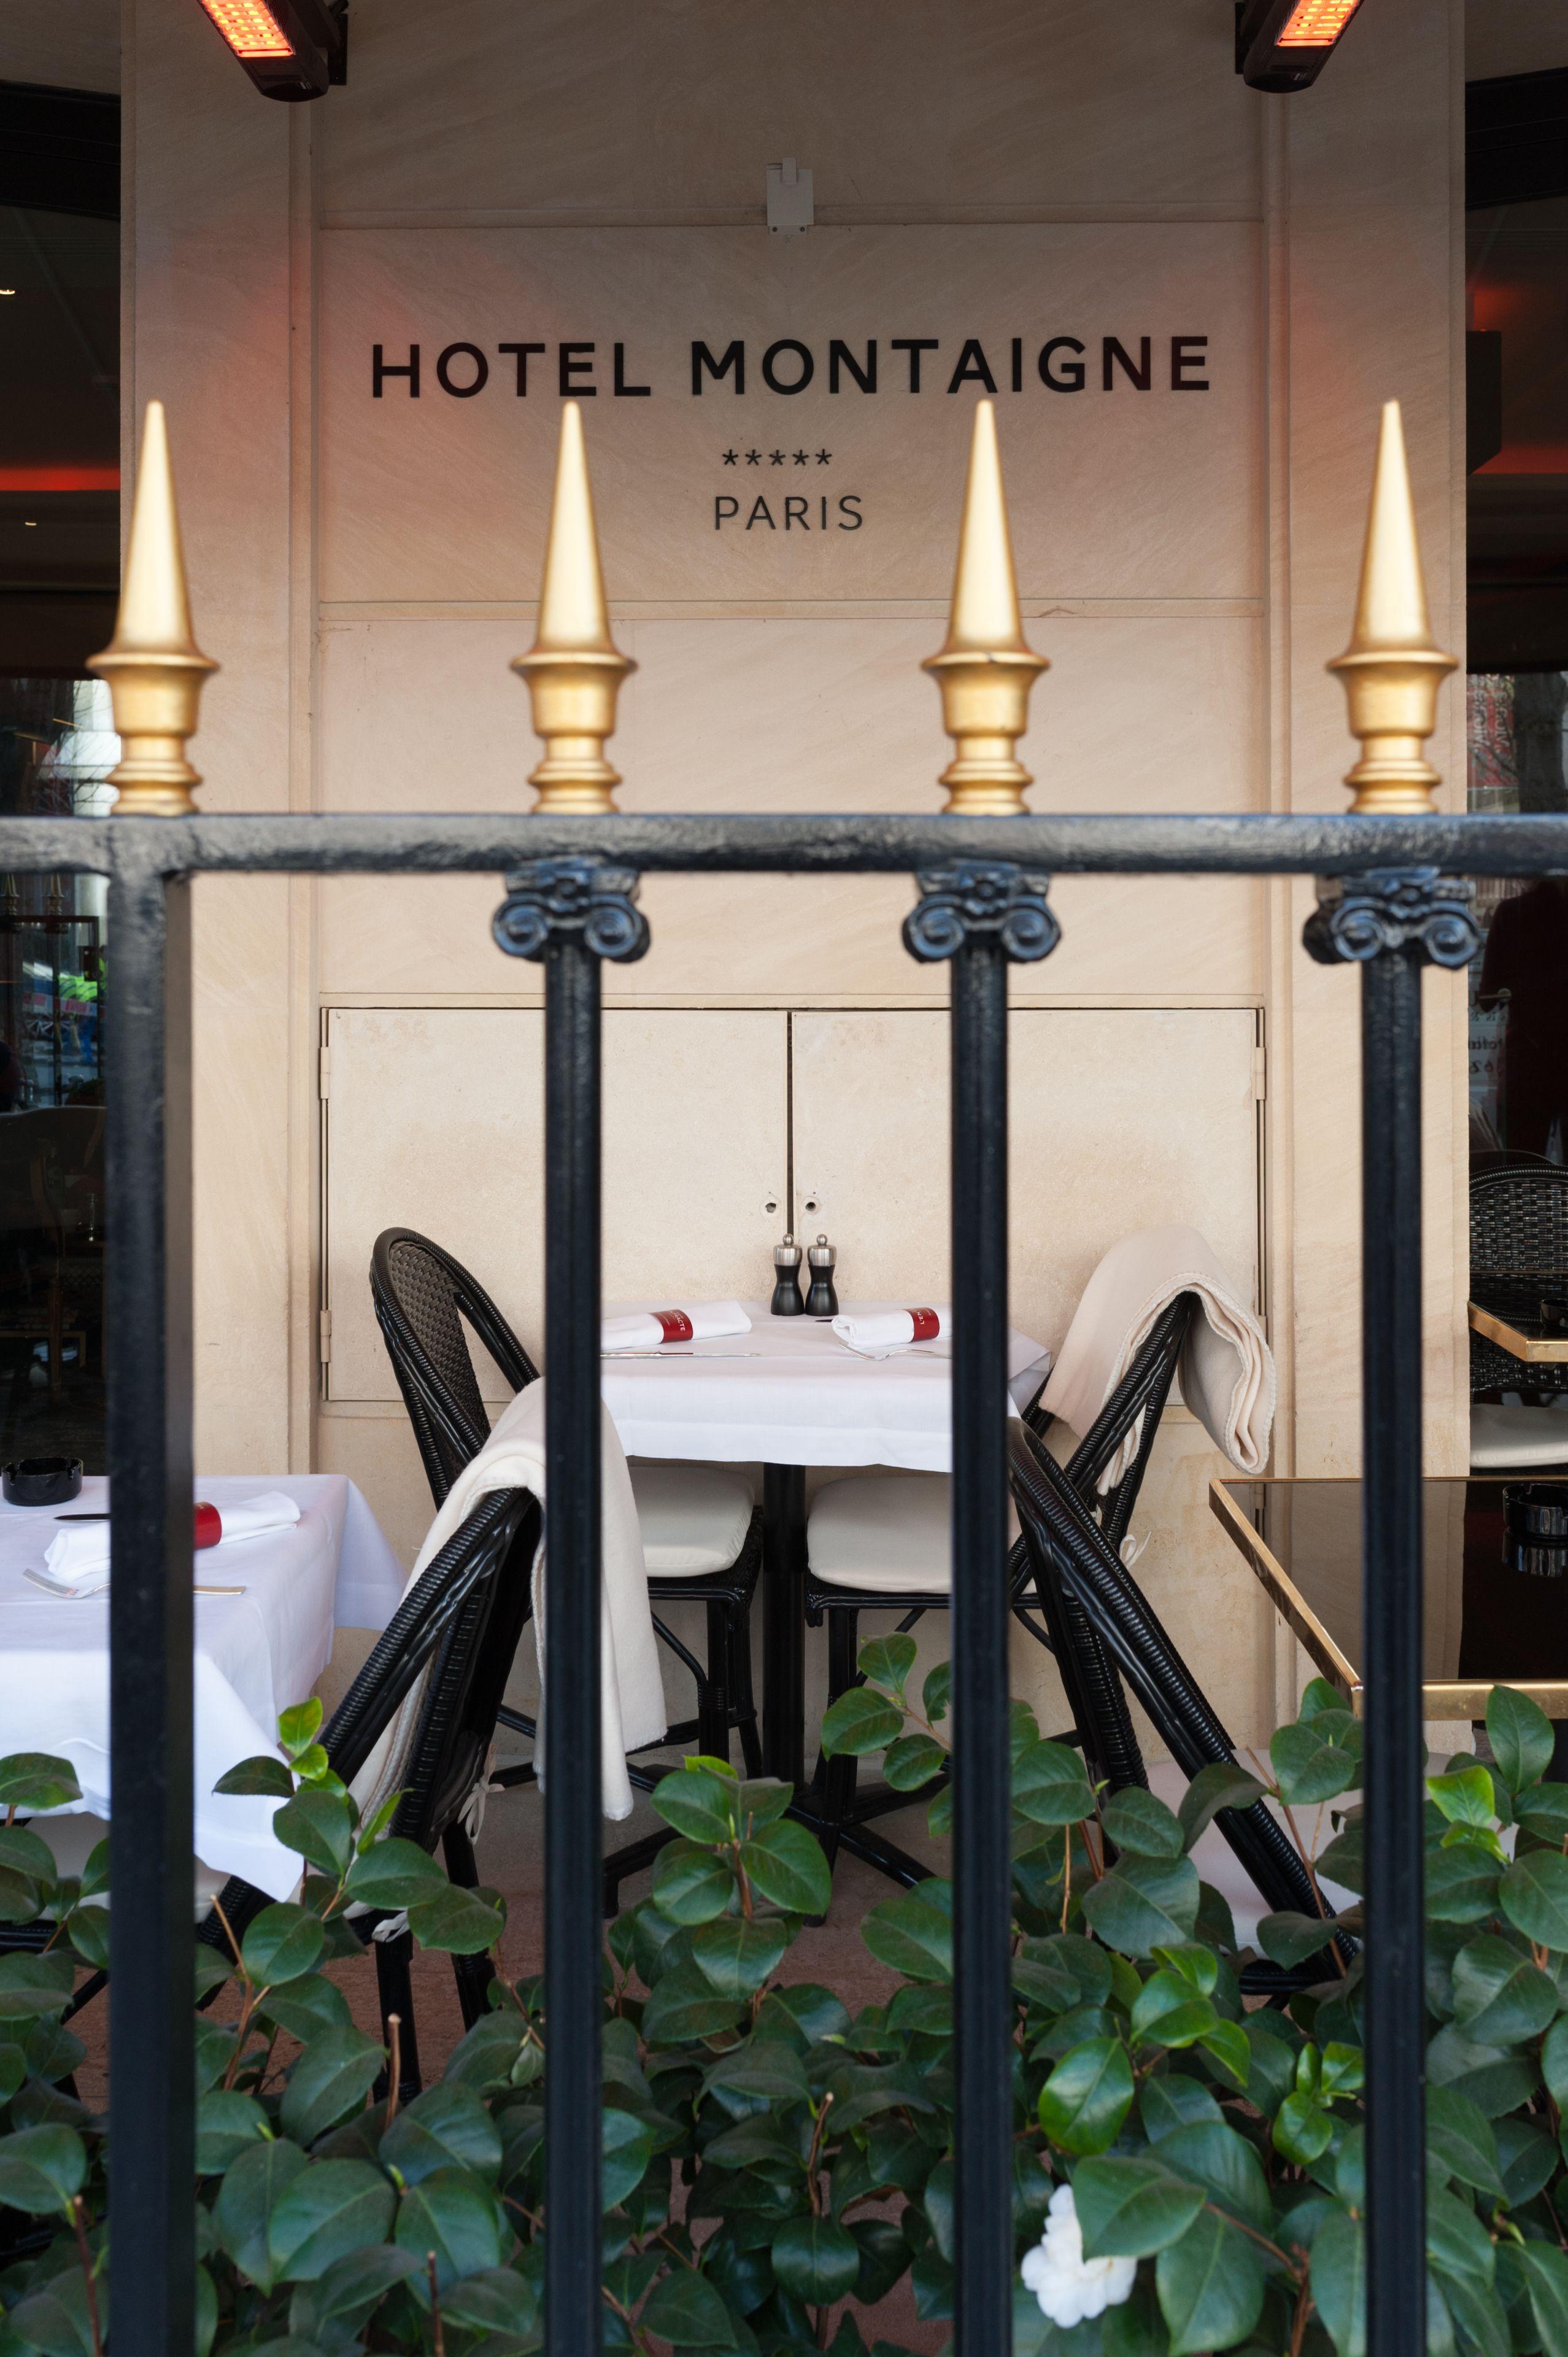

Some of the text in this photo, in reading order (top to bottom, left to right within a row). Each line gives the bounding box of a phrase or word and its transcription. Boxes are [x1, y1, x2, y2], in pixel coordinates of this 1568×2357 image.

[373, 336, 1210, 398] HOTEL MONTAIGNE
[715, 495, 862, 531] PARIS
